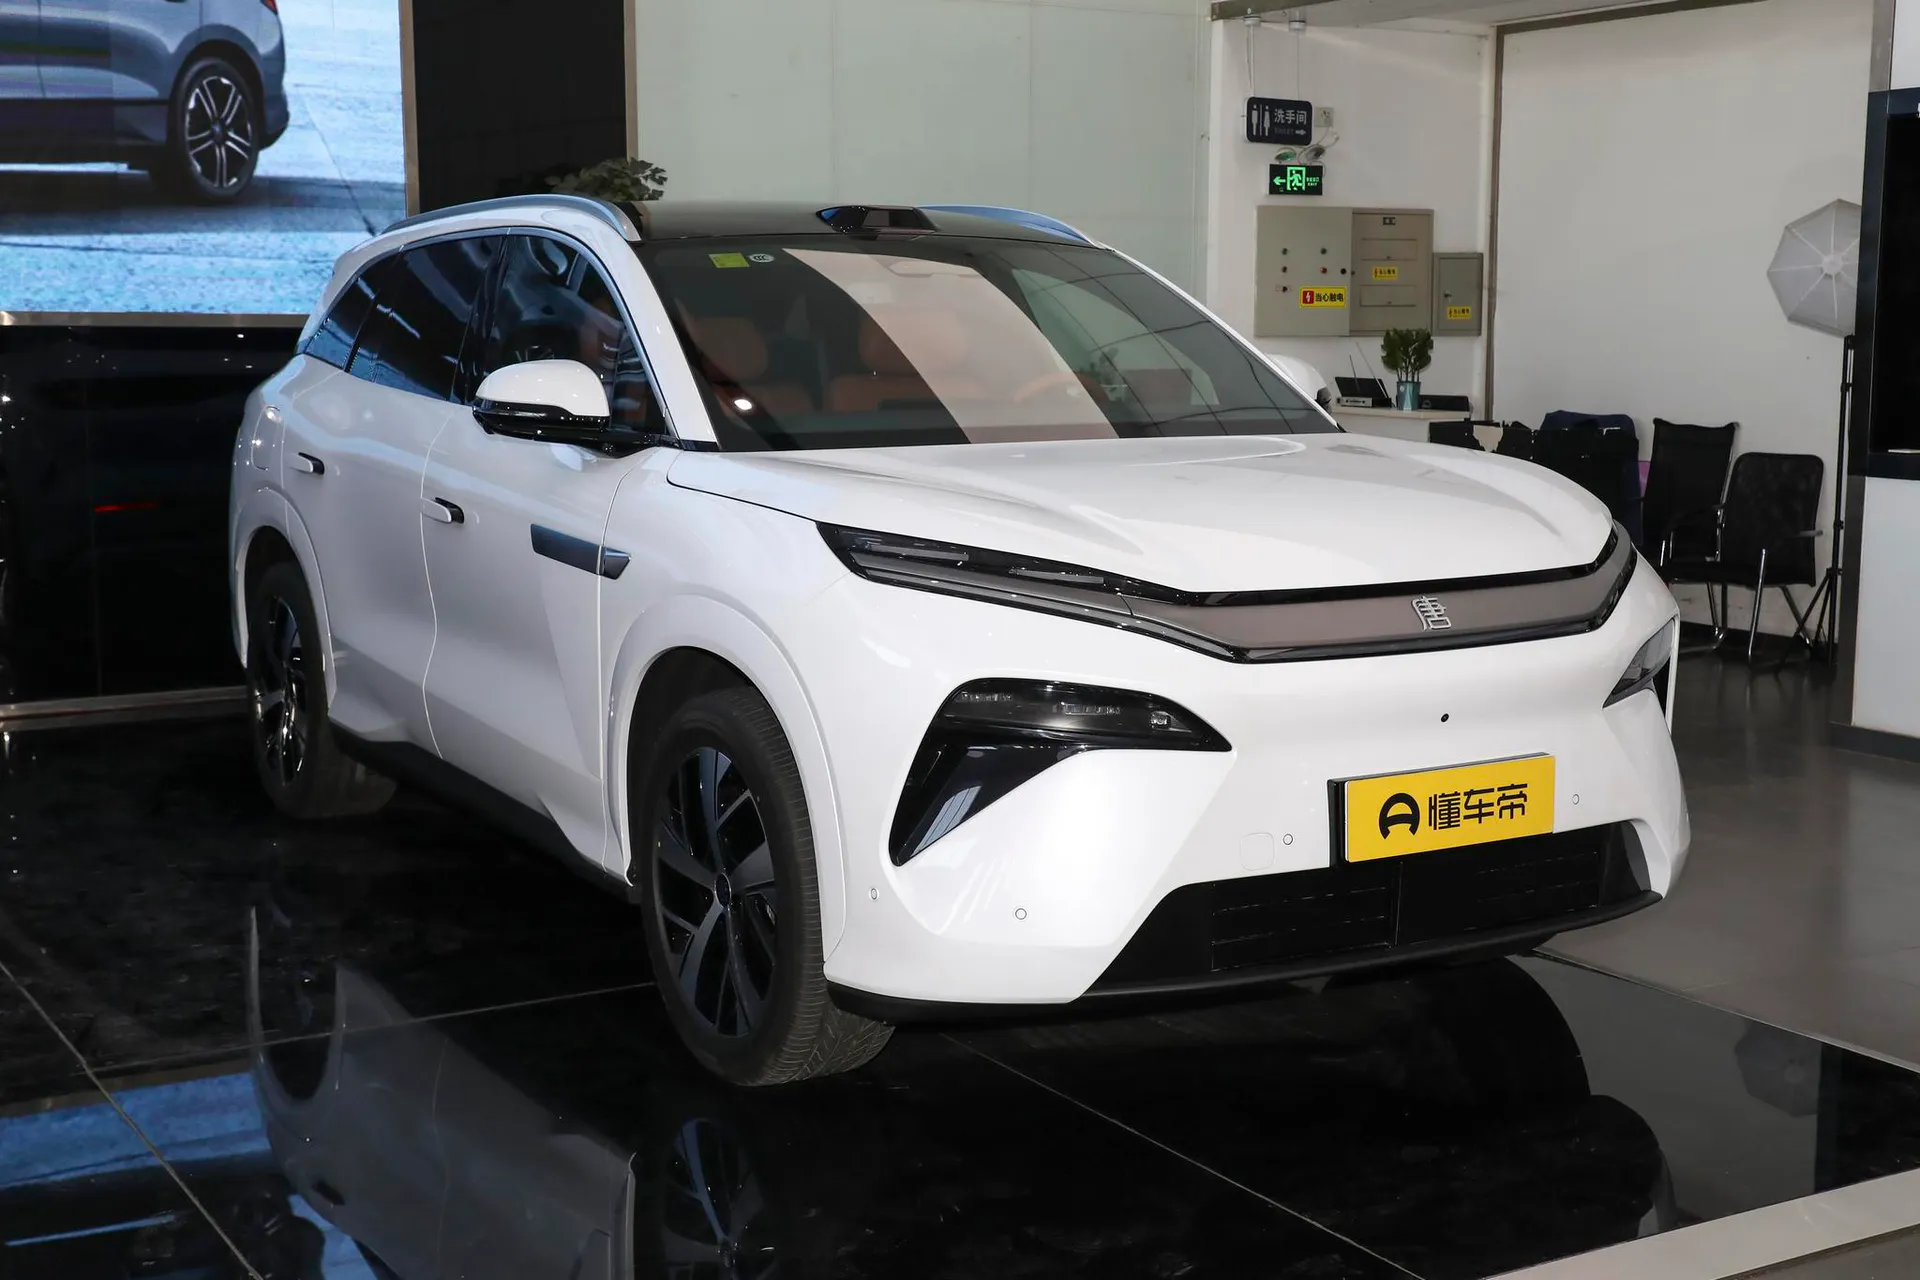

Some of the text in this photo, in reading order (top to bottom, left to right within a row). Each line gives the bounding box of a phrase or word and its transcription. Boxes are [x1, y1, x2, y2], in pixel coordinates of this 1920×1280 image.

[1274, 108, 1307, 125] 洗手间
[1315, 292, 1344, 302] 当心触电
[1428, 783, 1528, 831] 懂车帝
